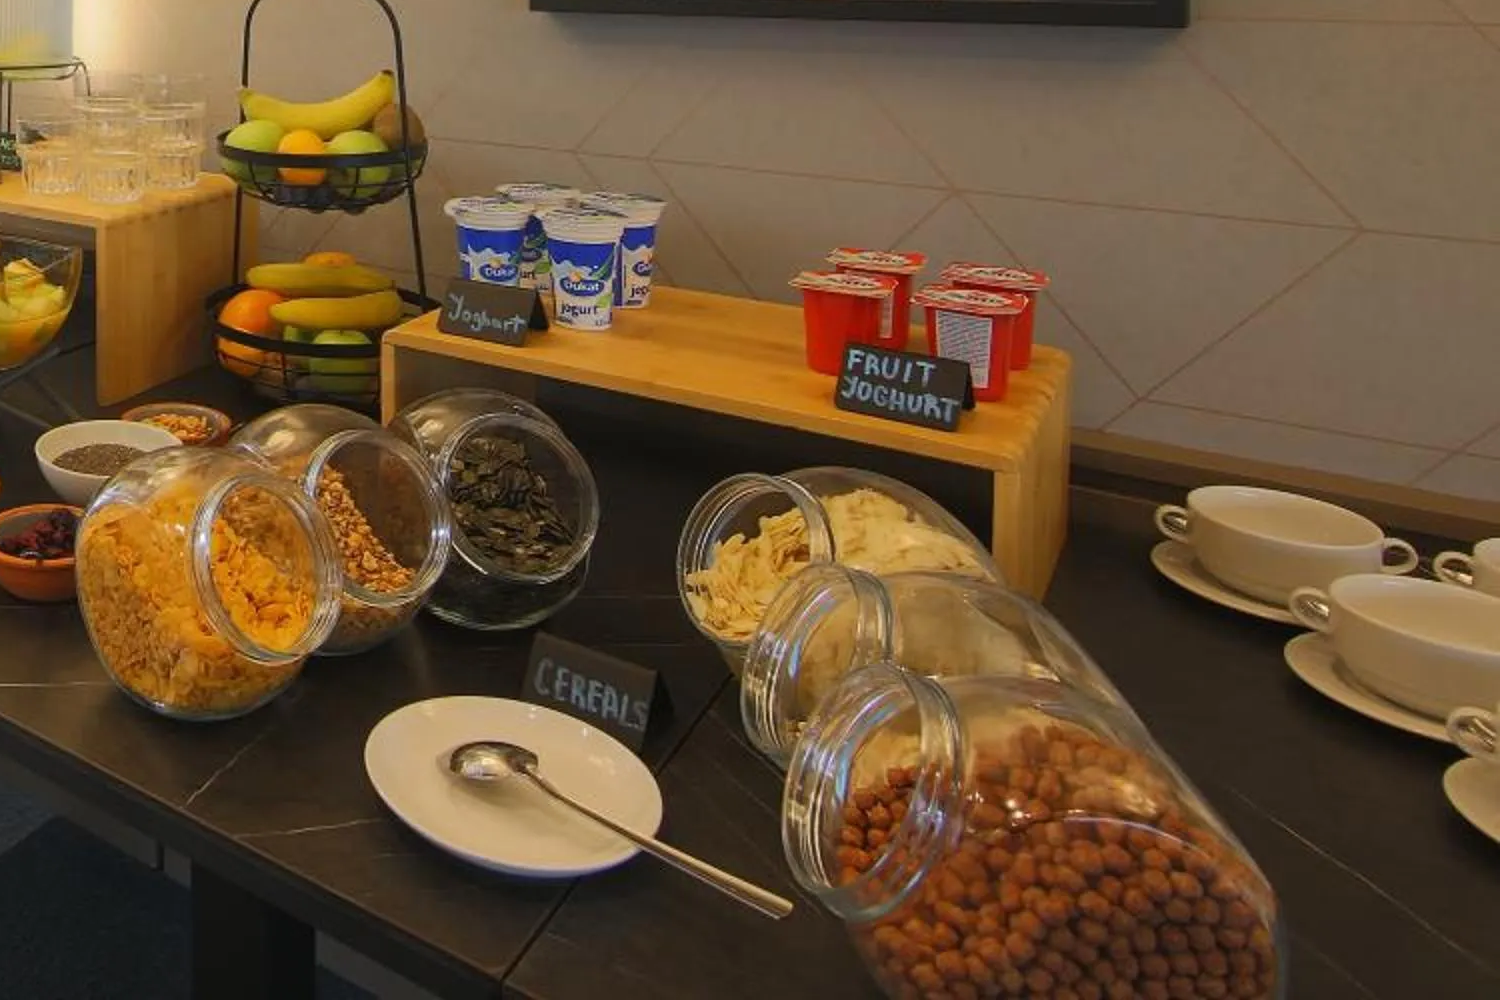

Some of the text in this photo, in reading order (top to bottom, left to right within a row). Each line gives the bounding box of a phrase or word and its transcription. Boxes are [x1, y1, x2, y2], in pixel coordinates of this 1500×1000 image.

[560, 301, 598, 317] jogurt
[847, 348, 937, 387] FRUIT
[534, 656, 650, 732] CEREALS
